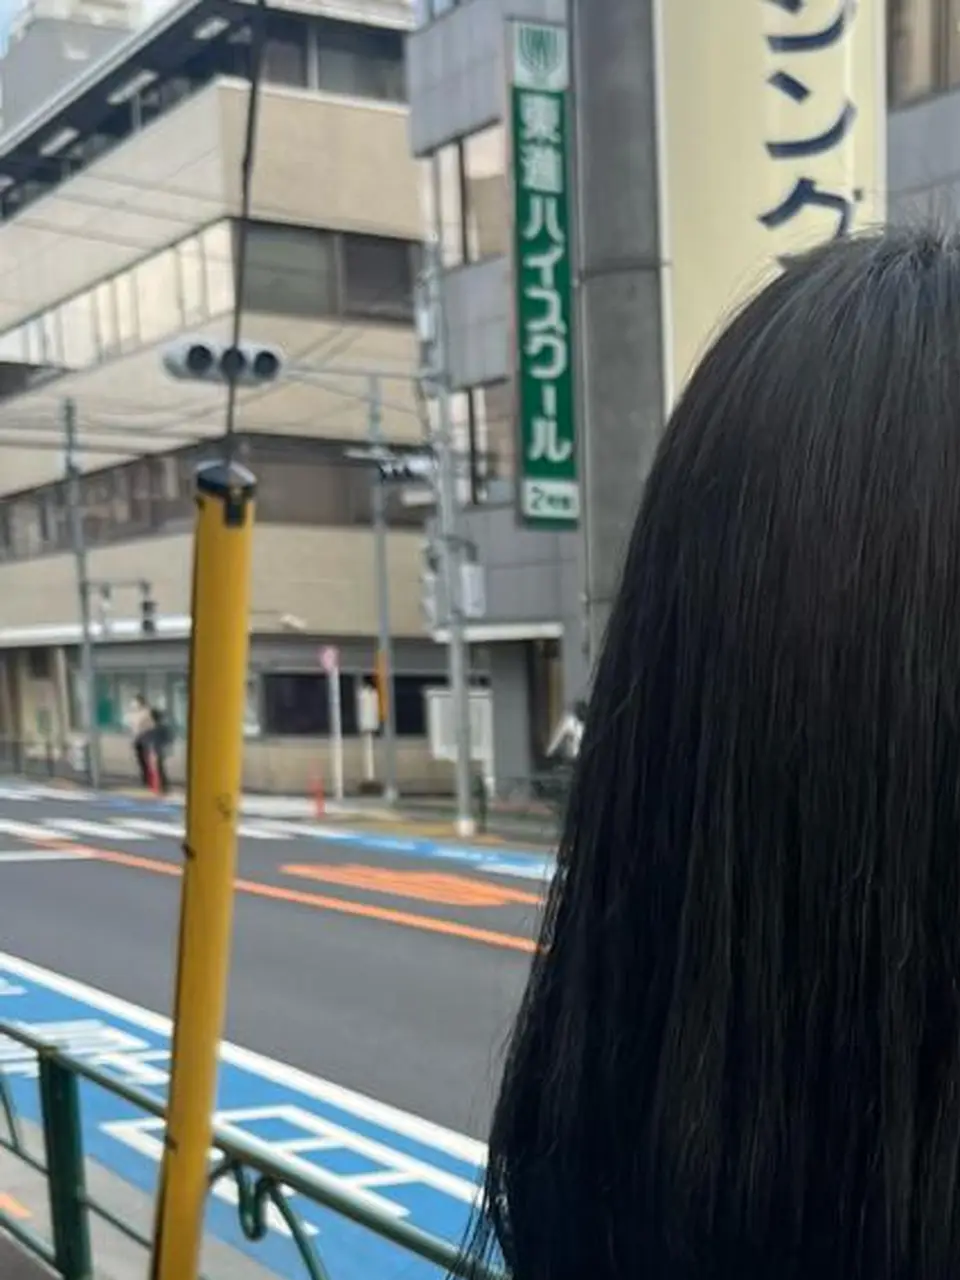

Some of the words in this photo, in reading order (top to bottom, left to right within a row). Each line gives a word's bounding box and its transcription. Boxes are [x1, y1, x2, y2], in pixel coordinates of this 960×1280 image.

[520, 94, 571, 463] 東進ハイスクール
